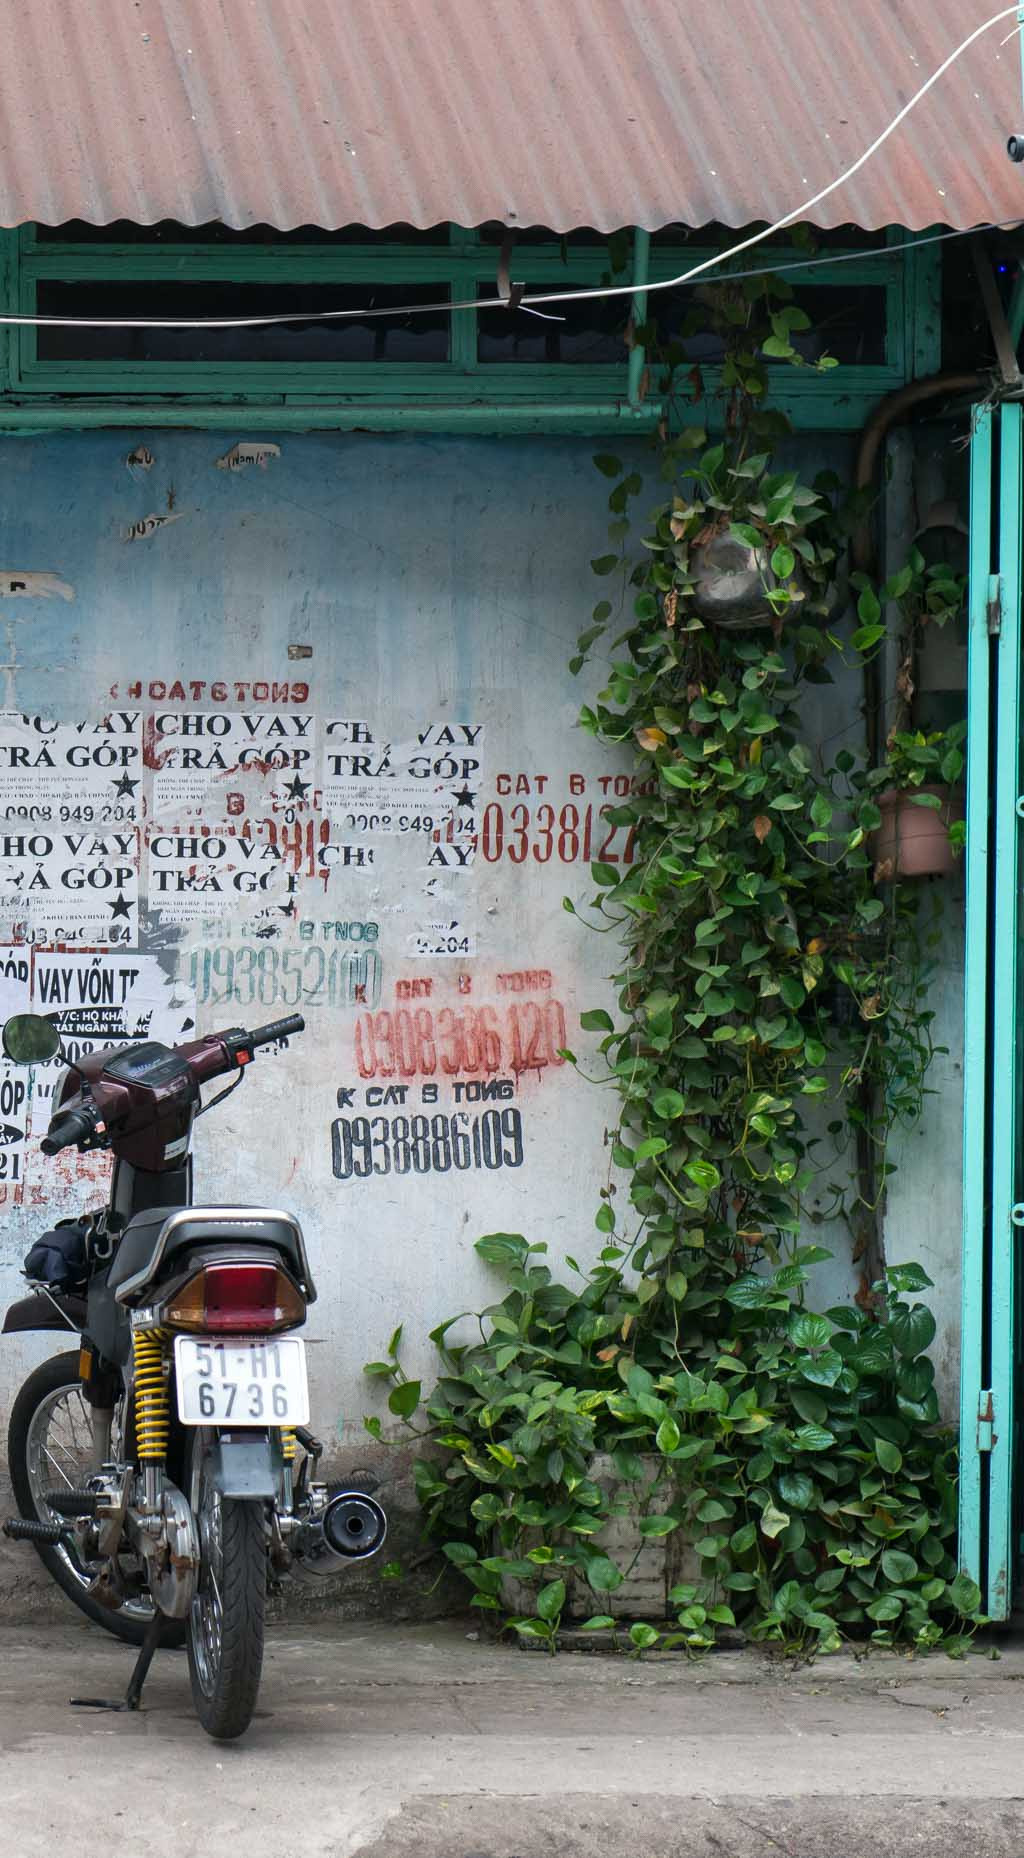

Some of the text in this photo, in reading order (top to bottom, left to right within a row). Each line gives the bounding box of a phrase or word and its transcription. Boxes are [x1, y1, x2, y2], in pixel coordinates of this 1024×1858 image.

[155, 714, 314, 737] CHO VAY
[66, 739, 139, 768] GÓP
[496, 774, 585, 796] CAT B
[59, 805, 94, 822] 949
[64, 834, 135, 857] VAY
[150, 836, 226, 859] CHO
[61, 861, 134, 890] GÓP
[38, 957, 114, 1005] VAY VỐN
[57, 1011, 80, 1025] Y/C:
[337, 1079, 515, 1108] K CAT B TONG
[331, 1107, 524, 1180] 0938886109
[198, 1382, 288, 1418] 6736
